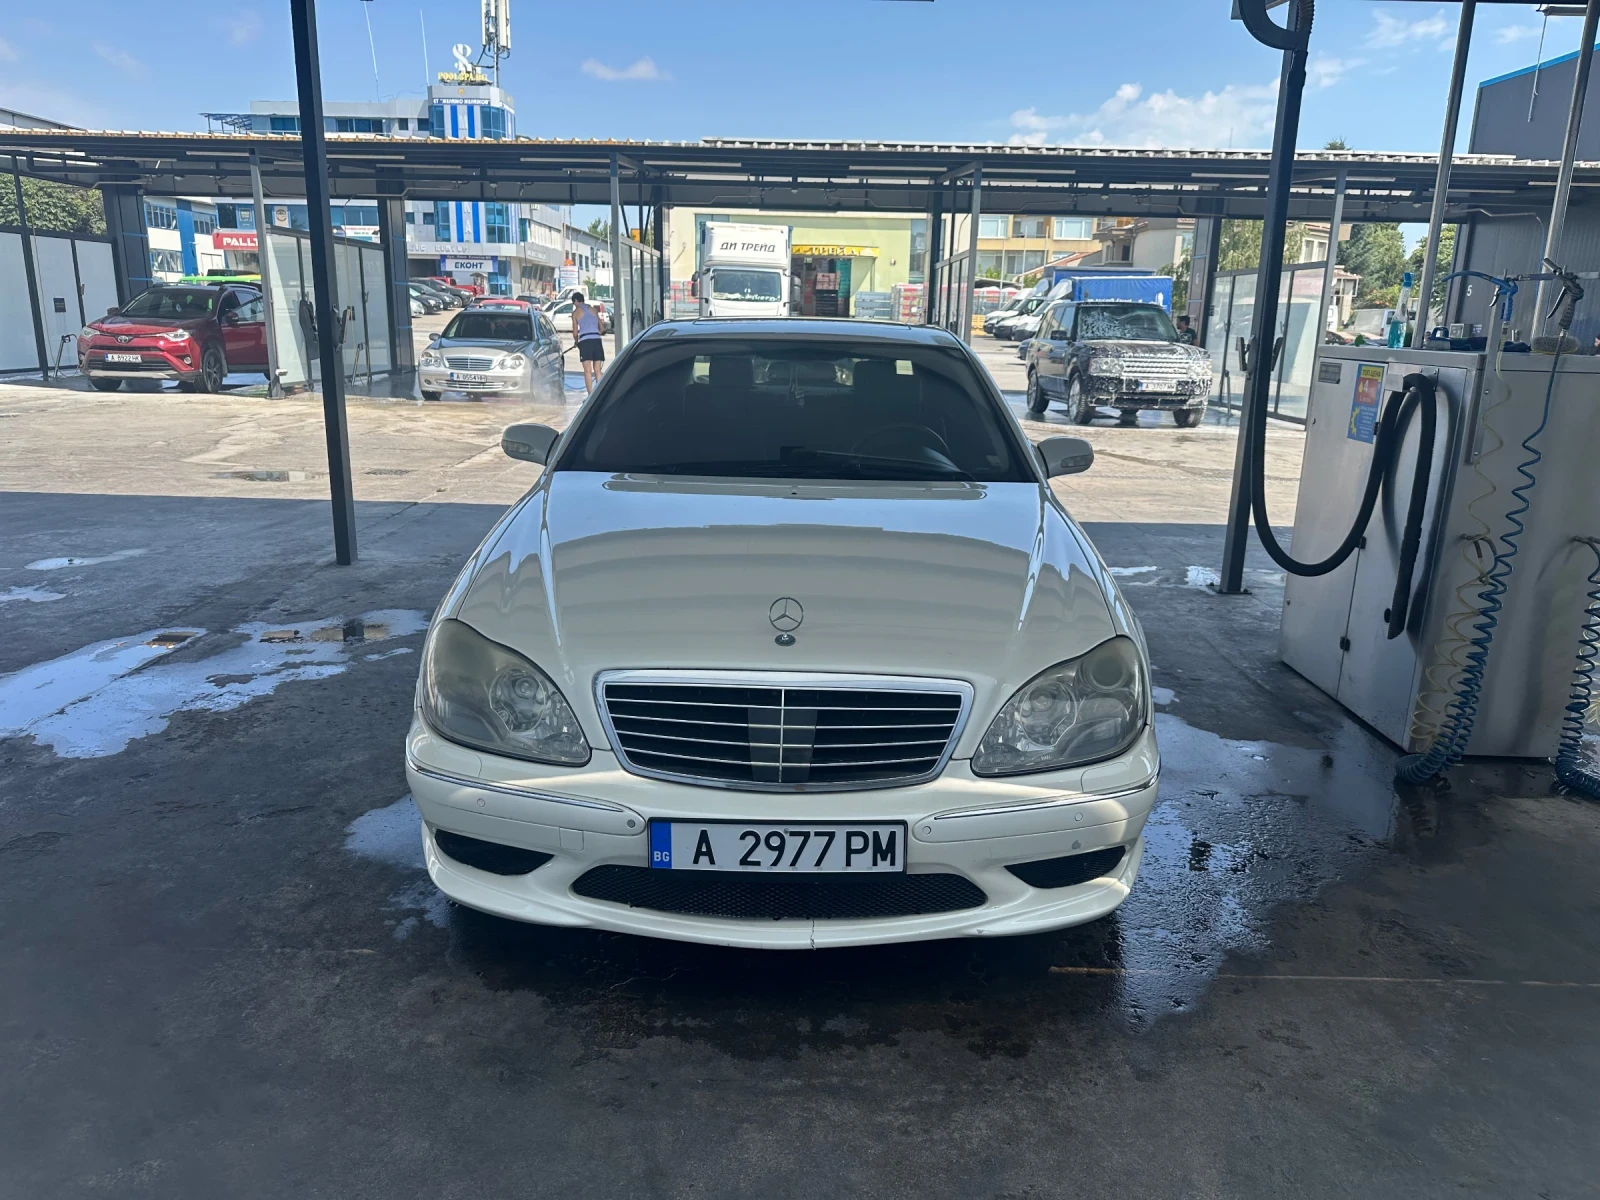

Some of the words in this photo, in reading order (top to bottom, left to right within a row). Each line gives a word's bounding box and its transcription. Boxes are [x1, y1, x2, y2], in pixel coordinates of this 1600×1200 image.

[720, 242, 737, 251] ДИ
[741, 242, 776, 252] ТРЕЙД
[454, 261, 484, 270] ЕКОНТ
[1466, 284, 1473, 297] 5
[693, 829, 716, 865] A
[653, 851, 670, 862] BG
